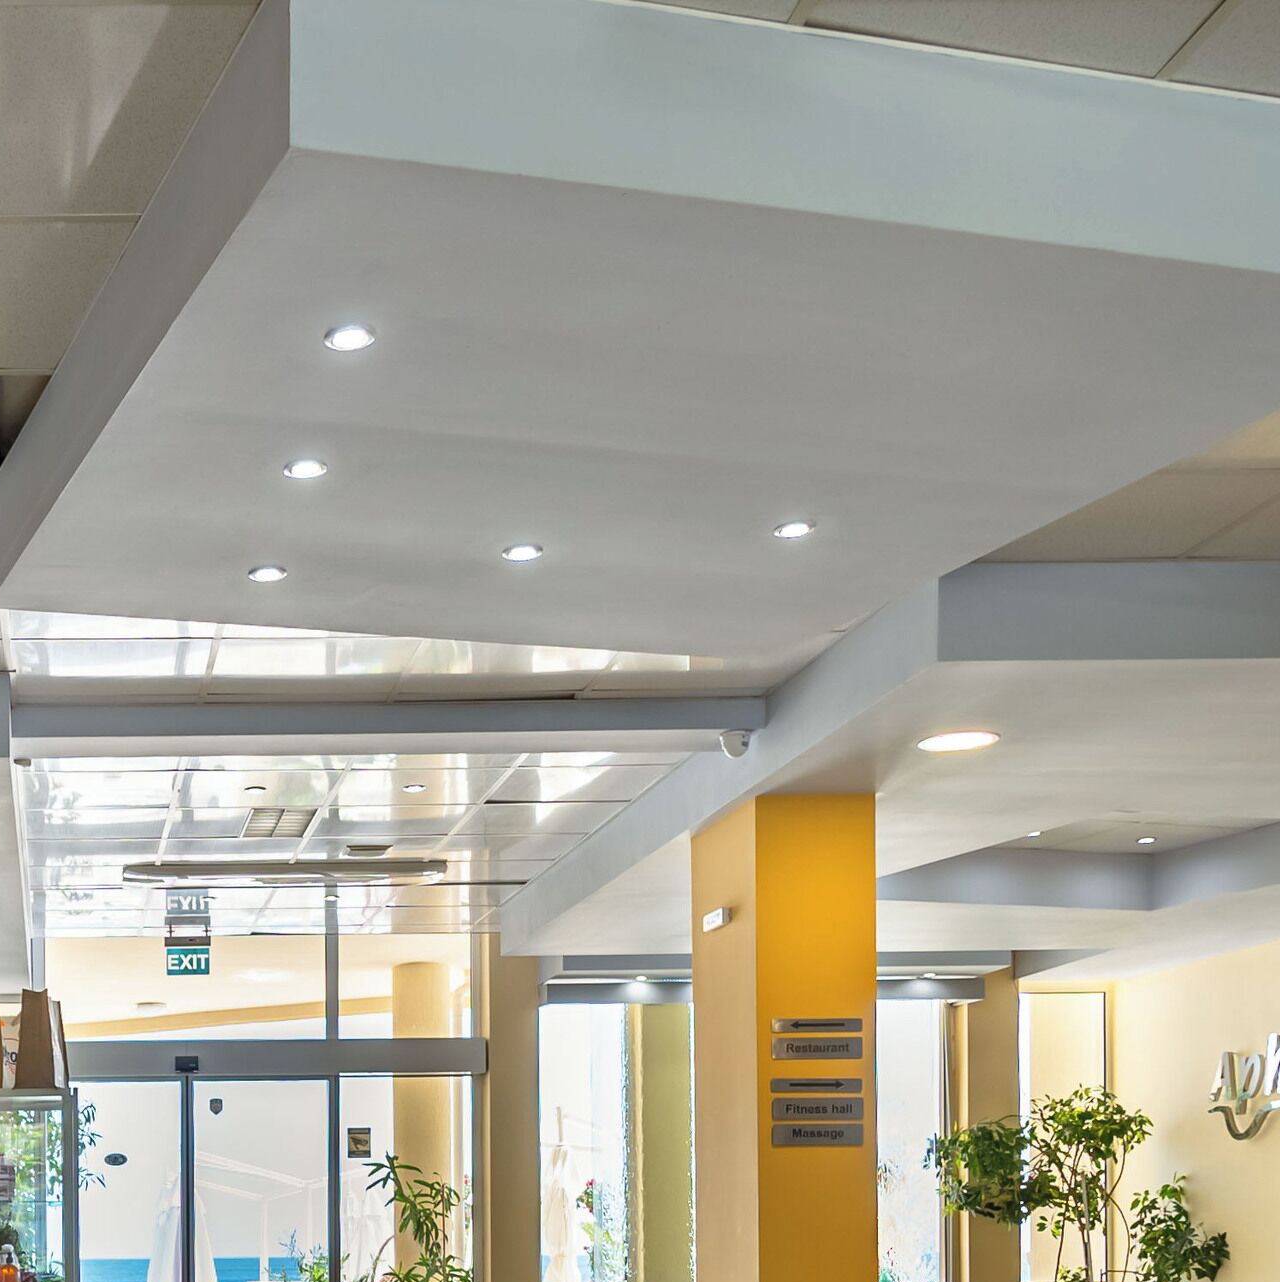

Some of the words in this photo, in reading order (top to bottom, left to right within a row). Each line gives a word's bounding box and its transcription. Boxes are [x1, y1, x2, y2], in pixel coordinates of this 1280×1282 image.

[167, 954, 208, 970] EXIT
[785, 1043, 850, 1054] Restaurant
[785, 1104, 828, 1115] Fitness
[831, 1104, 853, 1114] hall
[792, 1128, 845, 1139] Massage
